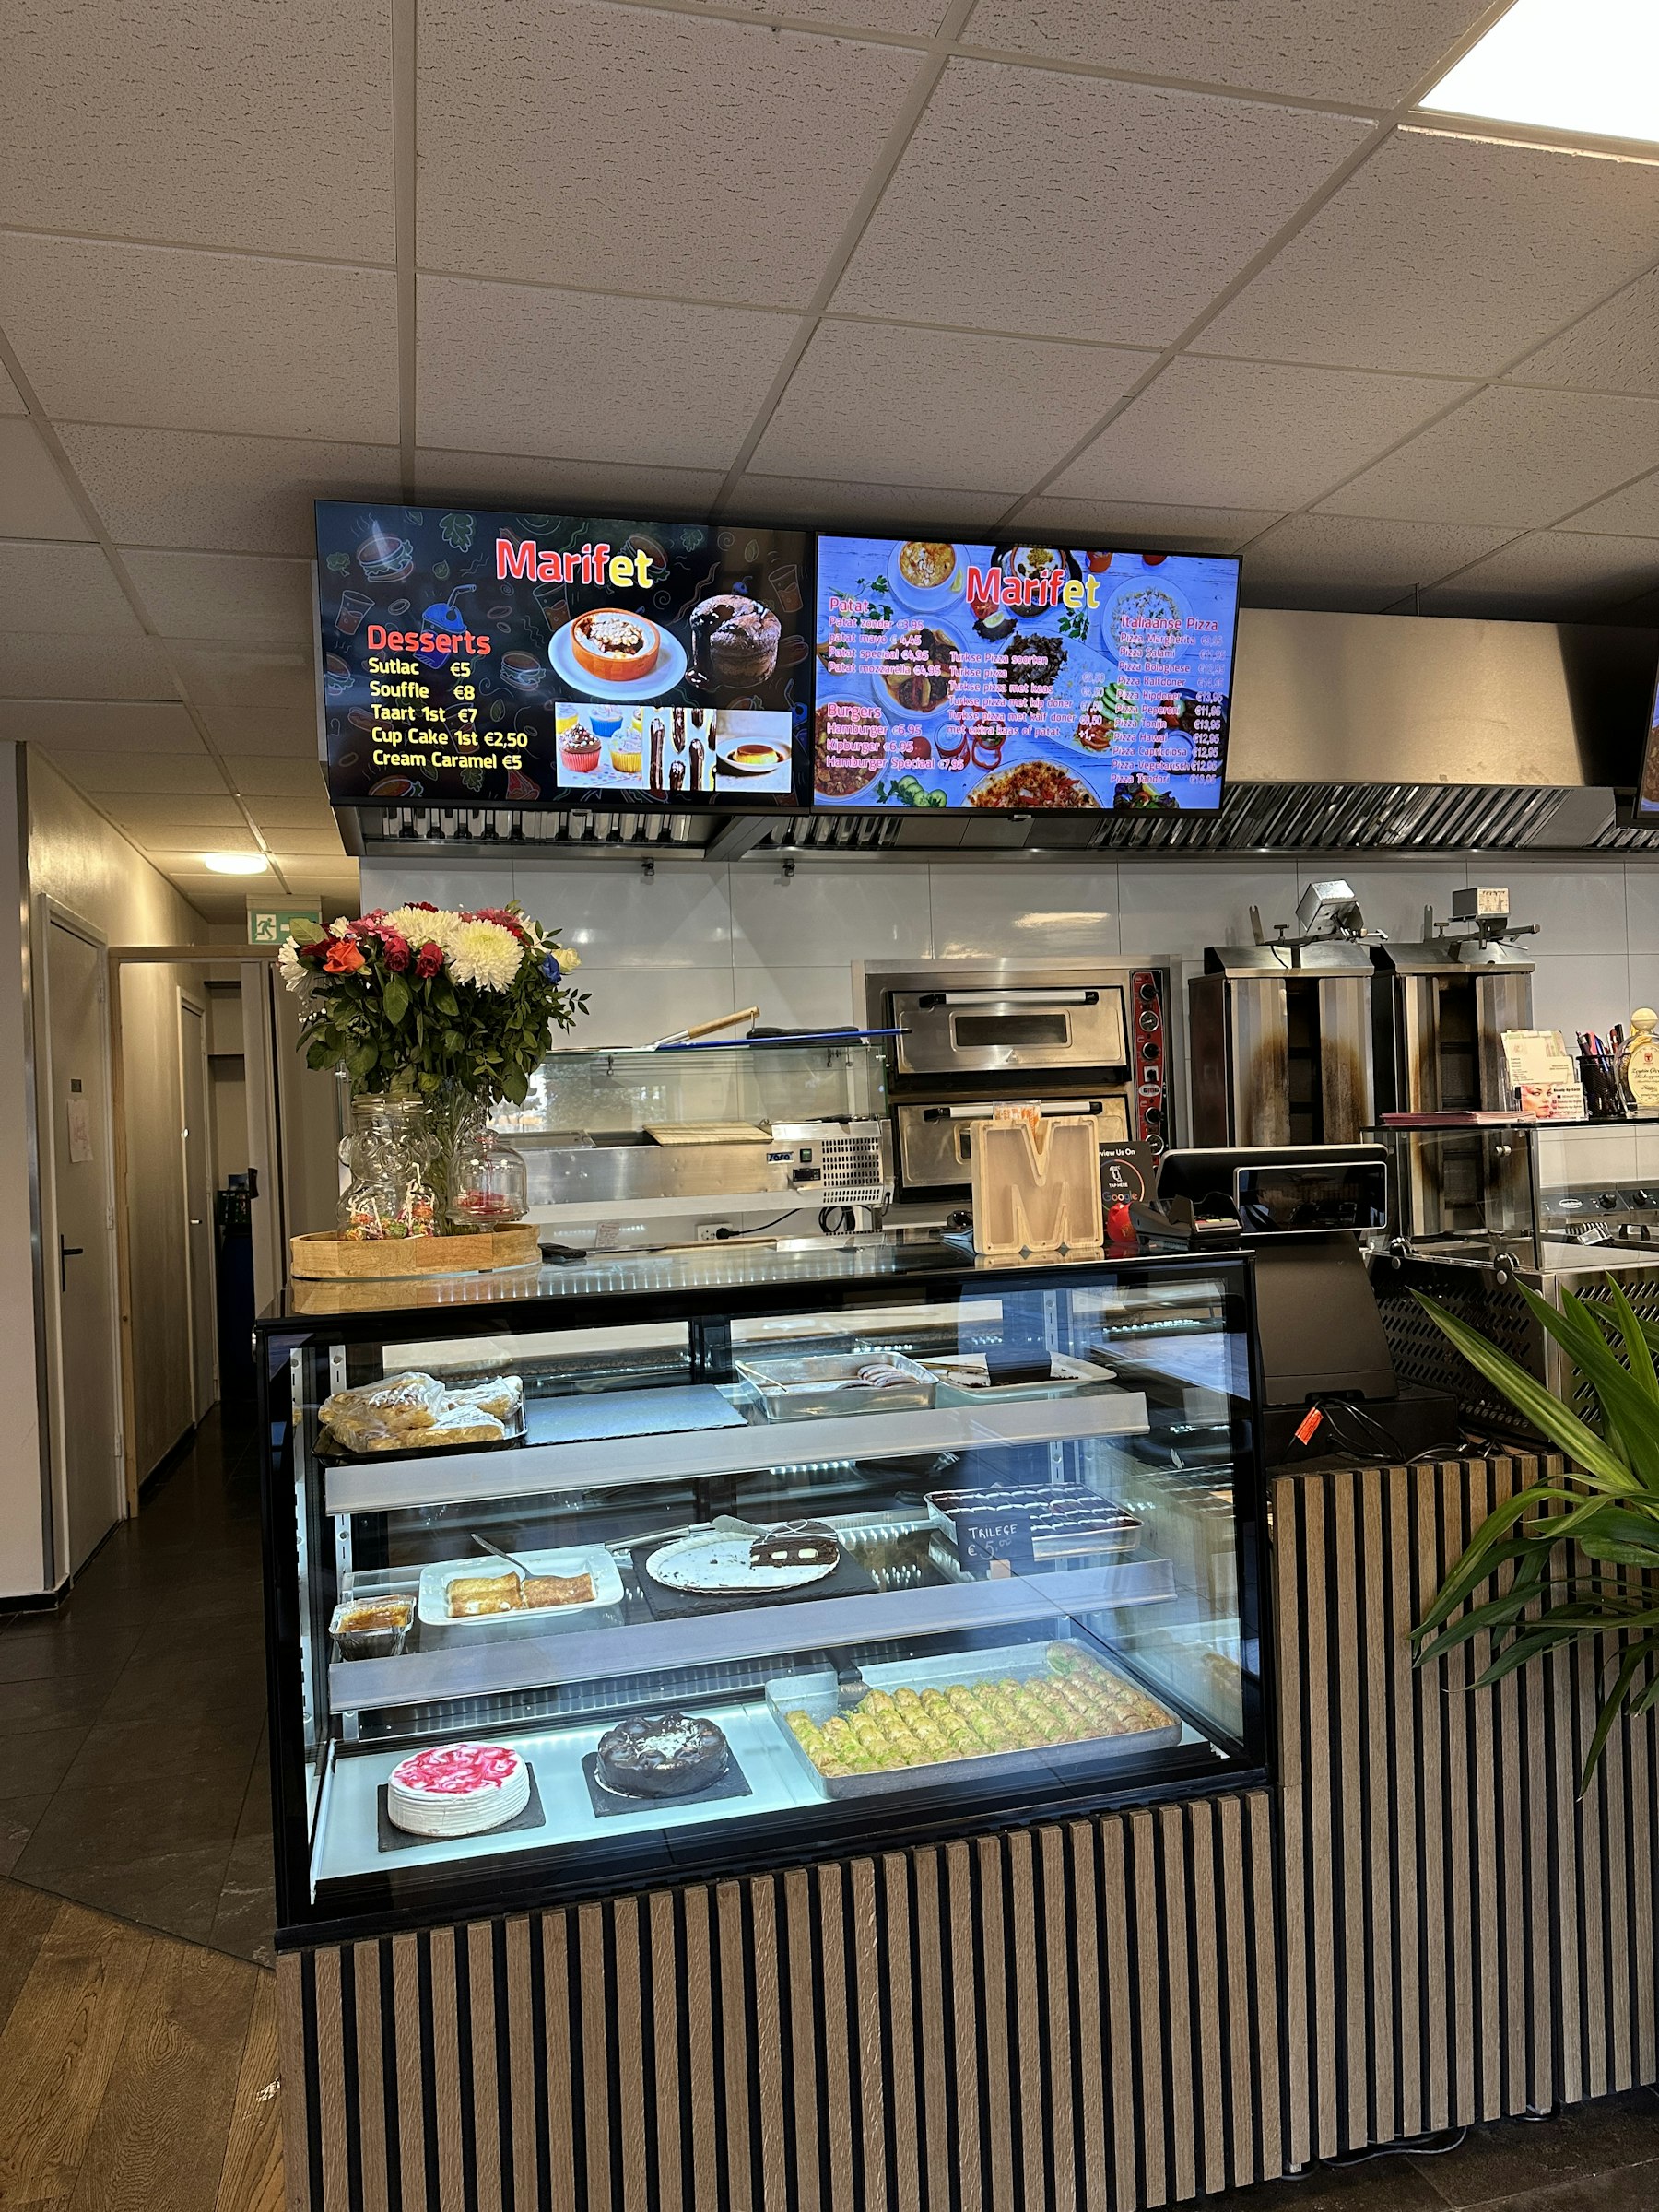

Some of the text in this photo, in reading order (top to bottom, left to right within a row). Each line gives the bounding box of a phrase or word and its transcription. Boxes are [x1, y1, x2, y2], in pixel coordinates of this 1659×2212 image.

[495, 538, 653, 589] Marifet
[966, 566, 1100, 609] Marifet
[830, 596, 870, 613] Patat
[829, 617, 858, 628] Patat
[861, 618, 894, 629] zonder
[1120, 614, 1218, 632] Italiaanse Pizza
[367, 624, 492, 655] Desserts
[829, 633, 856, 644] patat
[859, 634, 888, 645] mayo
[1120, 632, 1144, 642] Pizza
[1146, 633, 1195, 646] Margherita
[829, 646, 930, 663] Patat speciaal €4,95
[949, 651, 1049, 666] Turkse Pizza soorten
[1119, 647, 1143, 657] Pizza
[1146, 647, 1176, 658] Salami
[369, 657, 472, 677] Sutlac €5
[828, 661, 941, 677] Patat mozzarella €4,95
[949, 665, 982, 677] Turkse
[983, 668, 1007, 679] pizza
[1118, 661, 1142, 672] Pizza
[1145, 662, 1191, 675] Bolognese
[948, 680, 981, 692] Turkse
[982, 683, 1007, 695] pizza
[1009, 683, 1030, 693] met
[1030, 682, 1053, 694] kaas
[1118, 675, 1140, 686] Pizza
[370, 680, 476, 700] Souffle €8
[1116, 689, 1139, 700] Pizza
[947, 695, 980, 706] Turkse
[982, 697, 1006, 709] pizza
[1008, 698, 1028, 707] met
[1030, 697, 1044, 710] kip
[1047, 698, 1074, 709] doner
[1114, 703, 1138, 713] Pizza
[371, 704, 478, 724] Taart 1st €7
[827, 702, 882, 722] Burgers
[947, 710, 980, 722] Turkse
[981, 712, 1005, 724] pizza
[1008, 712, 1028, 723] met
[1030, 711, 1047, 723] kalf
[1050, 712, 1077, 724] doner
[826, 722, 888, 738] Hamburger
[947, 724, 967, 735] met
[968, 724, 994, 735] extra
[996, 724, 1019, 736] kaas
[1022, 724, 1032, 736] of
[1034, 726, 1060, 738] patat
[1113, 718, 1137, 728] Pizza
[1141, 718, 1168, 731] Tonijn
[371, 726, 528, 749] Cup Cake 1st €2,50
[1112, 732, 1136, 742] Pizza
[826, 738, 881, 754] Kipburger
[1112, 745, 1135, 756] Pizza
[372, 749, 523, 771] Cream Caramel €5
[826, 755, 888, 771] Hamburger
[890, 756, 935, 771] Speciaal
[1111, 759, 1135, 770] Pizza
[1137, 759, 1191, 772] Vegetarisch
[1110, 772, 1134, 783] Pizza
[1115, 1148, 1124, 1157] Us
[1124, 1147, 1135, 1156] On
[1102, 1190, 1138, 1203] Google
[968, 1544, 978, 1557] €
